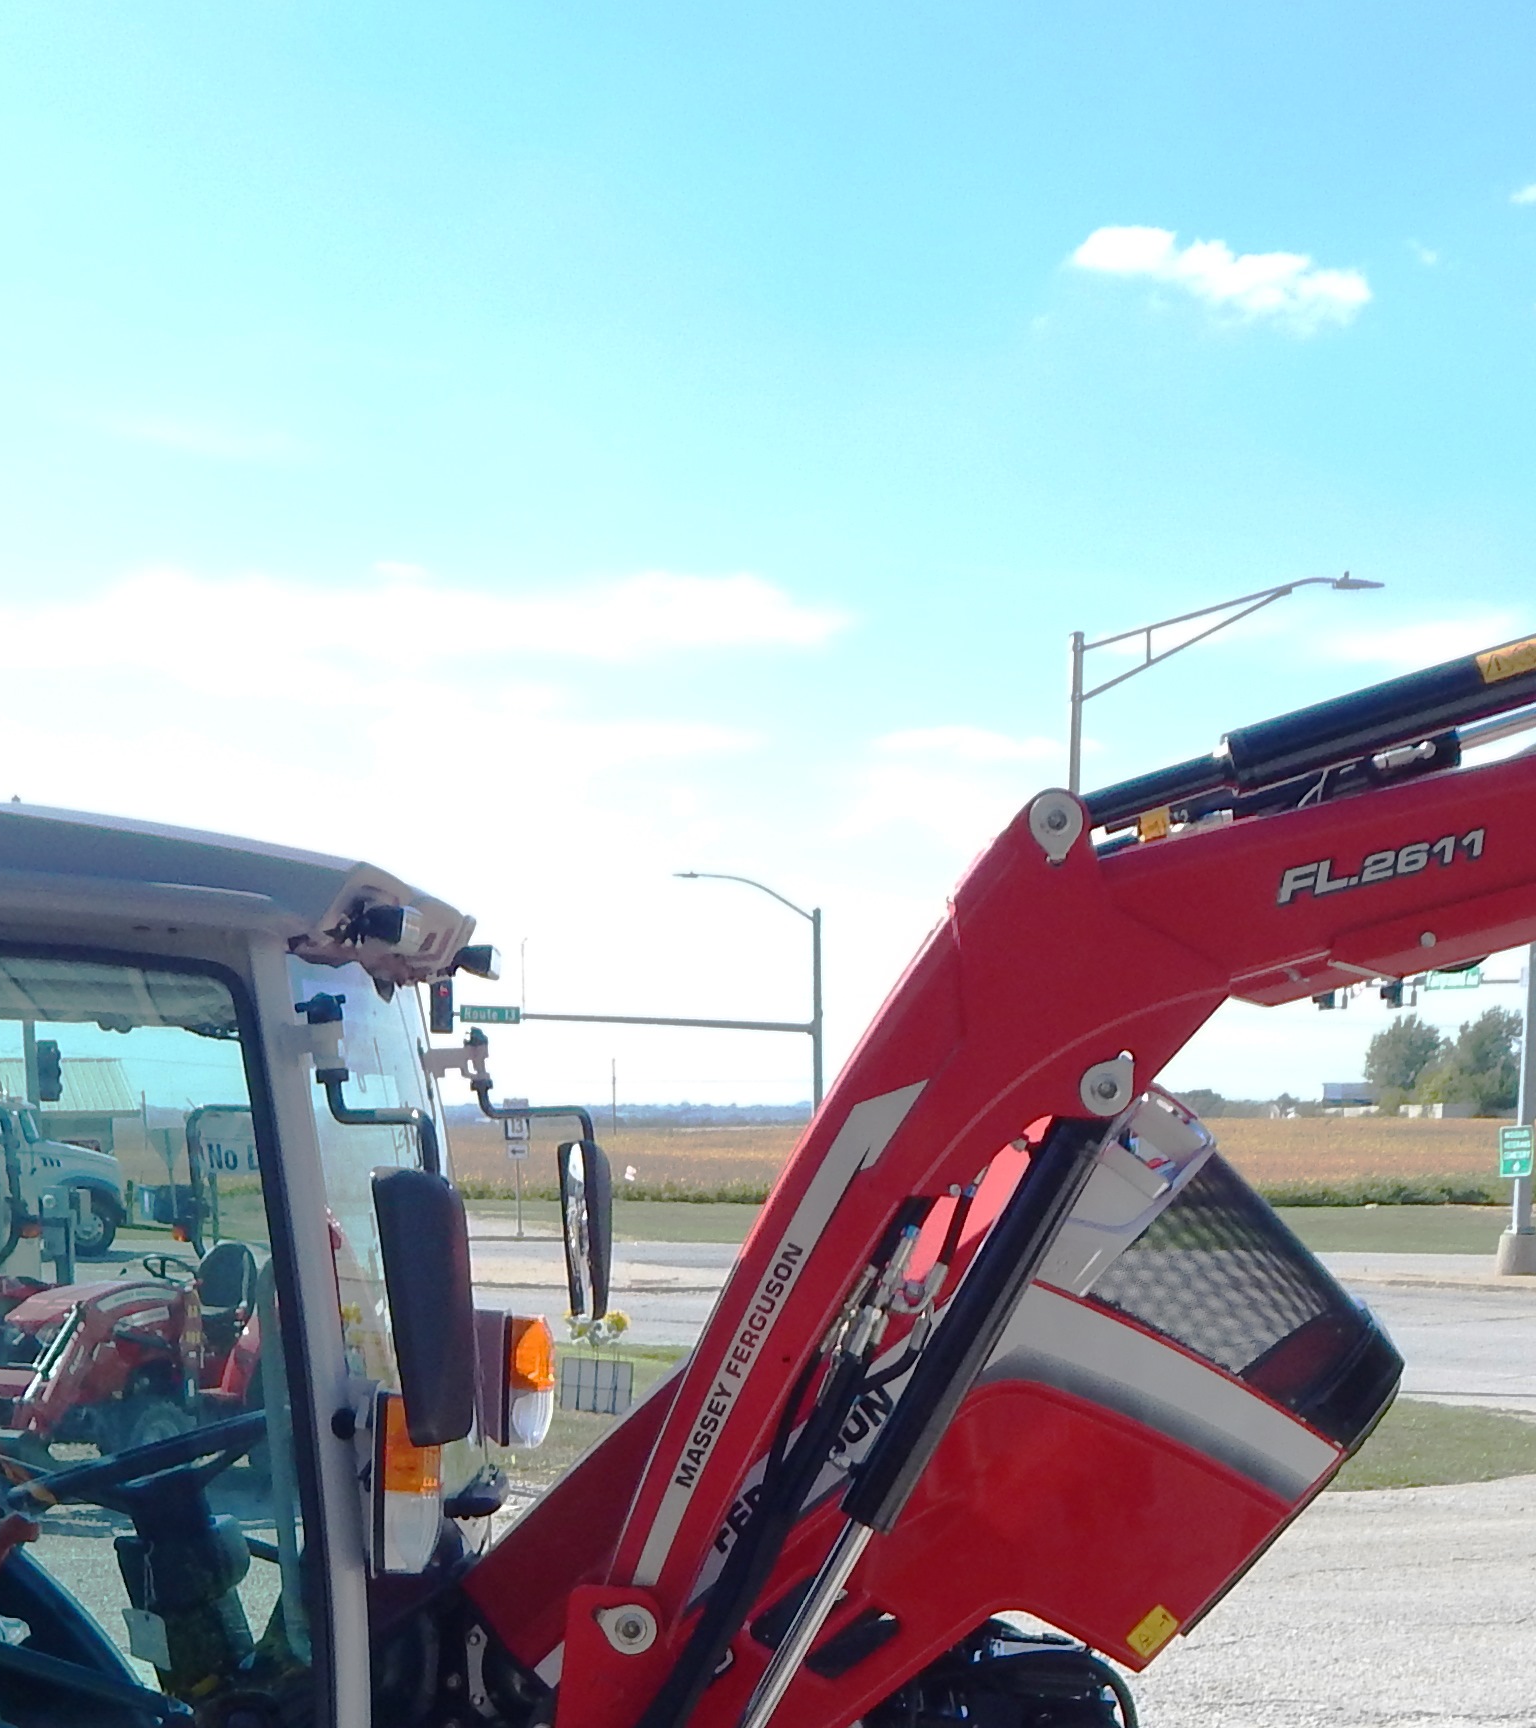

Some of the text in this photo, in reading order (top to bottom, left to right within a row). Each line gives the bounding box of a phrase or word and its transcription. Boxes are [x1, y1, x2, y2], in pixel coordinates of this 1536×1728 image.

[1276, 827, 1486, 905] FL.2611
[464, 1007, 516, 1021] Route 13
[207, 1143, 239, 1170] No
[675, 1242, 804, 1488] MASSEY FERGUSON
